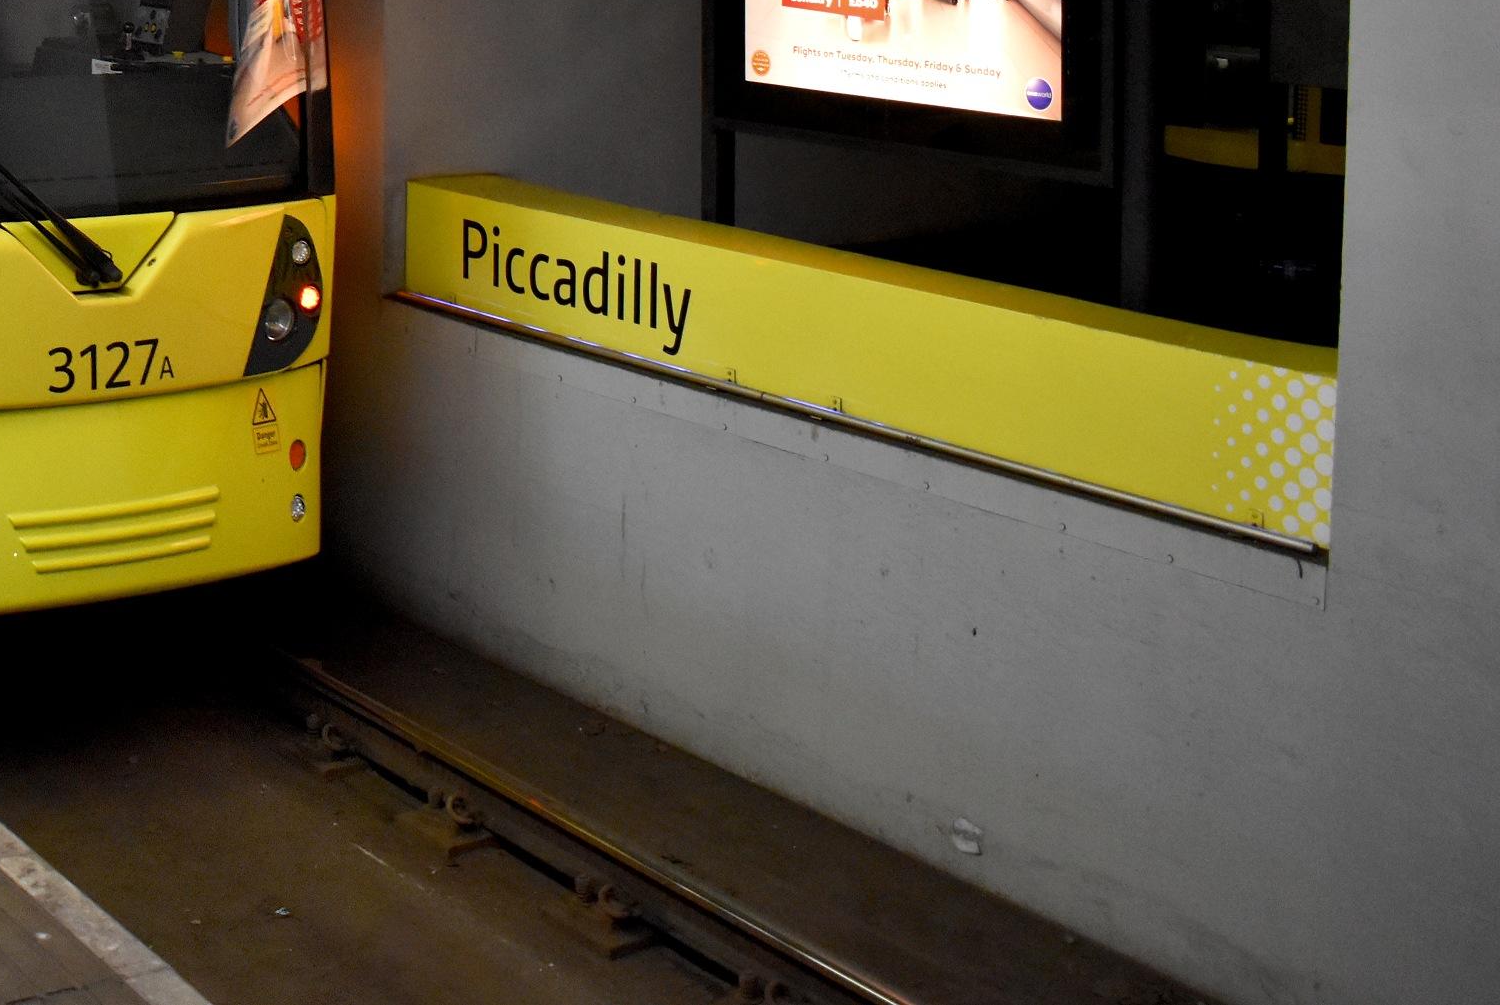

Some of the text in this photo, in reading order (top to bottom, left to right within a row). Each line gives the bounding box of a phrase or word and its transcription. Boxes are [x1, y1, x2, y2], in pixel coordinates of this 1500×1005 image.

[793, 45, 822, 59] Flights
[823, 50, 835, 58] on
[924, 59, 954, 74] Friday
[964, 64, 1002, 78] Sunday
[462, 218, 692, 356] Piccadilly
